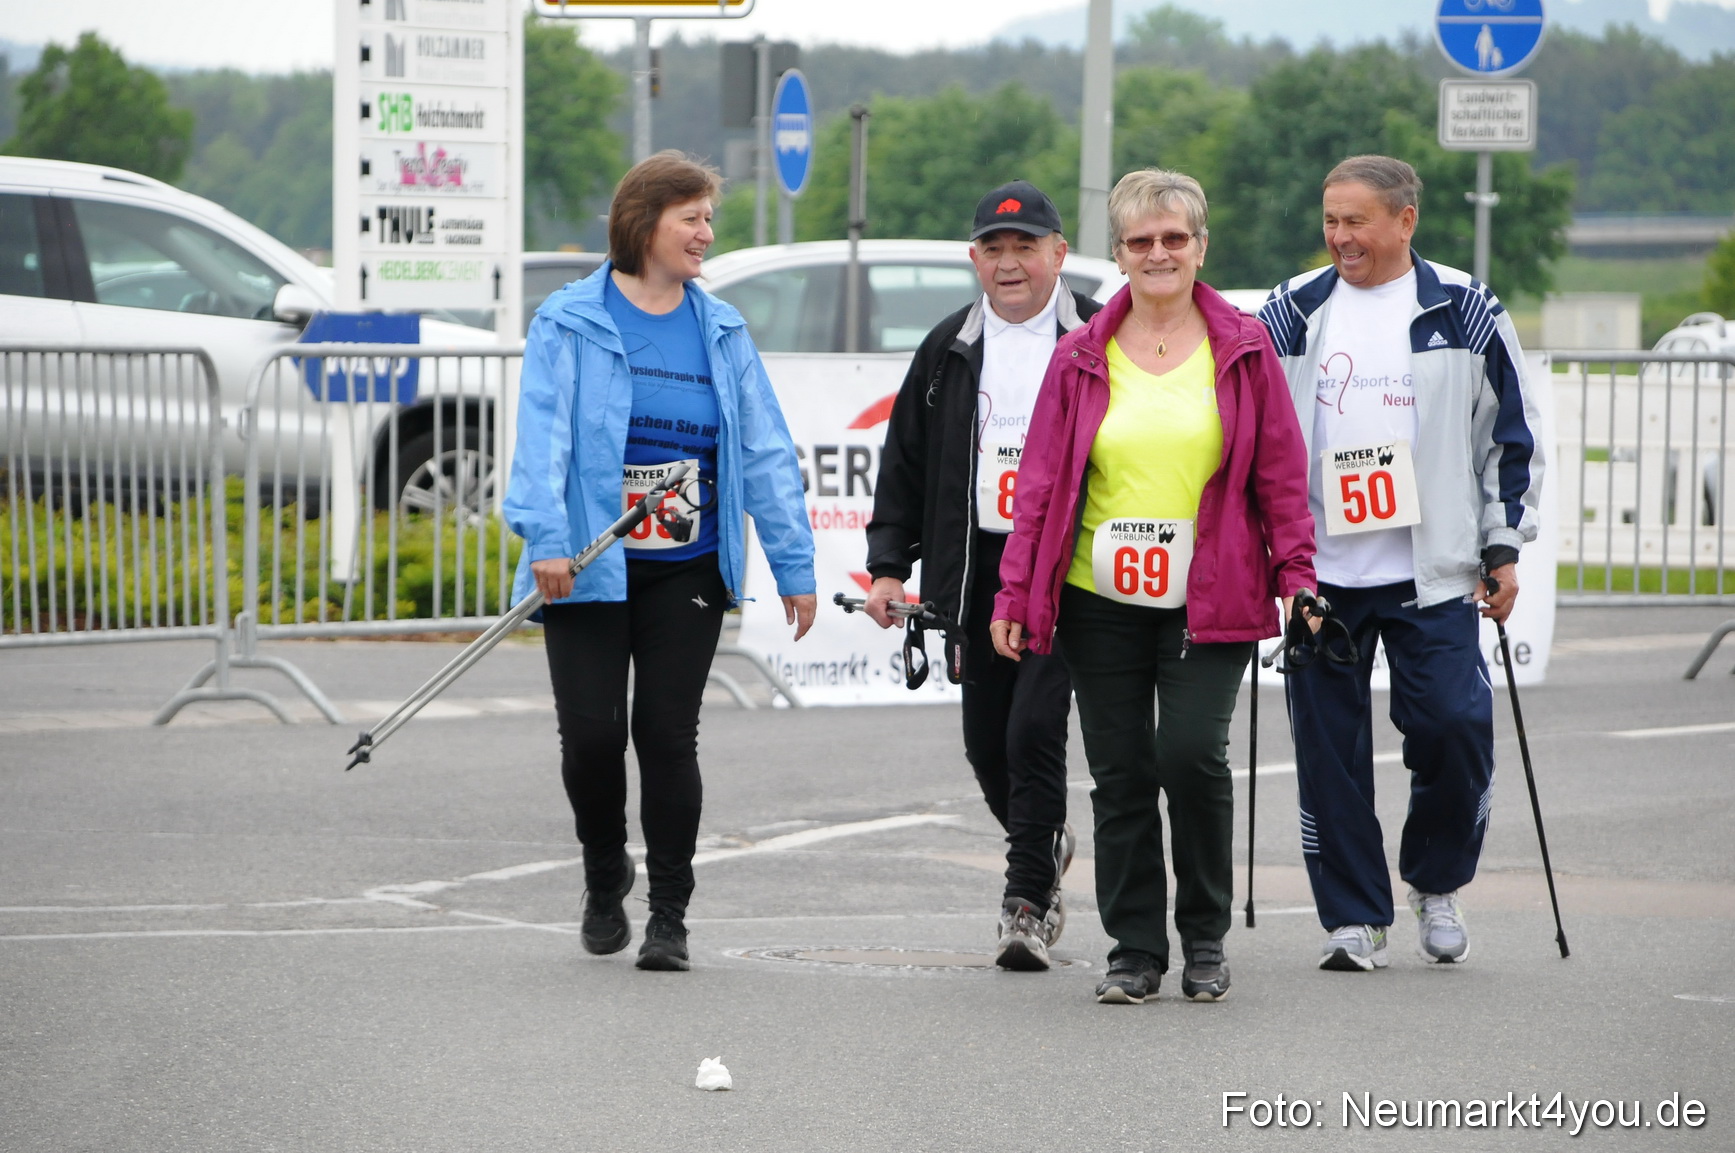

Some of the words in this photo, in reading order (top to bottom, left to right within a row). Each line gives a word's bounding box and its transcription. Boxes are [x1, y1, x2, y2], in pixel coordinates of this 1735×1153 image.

[1457, 88, 1517, 103] Landwirt-
[378, 92, 413, 132] SHB
[1451, 106, 1524, 120] schaftlicher
[1451, 123, 1497, 137] Verkehr
[1503, 122, 1523, 136] frei
[377, 205, 434, 244] THULE
[1317, 377, 1336, 388] erz
[1352, 375, 1389, 390] Sport
[1402, 373, 1414, 387] G
[676, 419, 699, 435] Sie
[991, 414, 1027, 429] Sport
[997, 447, 1022, 458] MEY
[1334, 448, 1374, 462] MEYER
[997, 457, 1021, 466] WERB
[1334, 459, 1376, 470] WERBUNG
[622, 468, 664, 479] MEYER
[998, 470, 1018, 520] 8
[1340, 470, 1396, 524] 50
[810, 503, 873, 529] tohau
[1110, 522, 1155, 533] MEYER
[1110, 533, 1155, 541] WERBUNG
[1114, 546, 1169, 598] 69
[767, 651, 869, 687] Neumarkt
